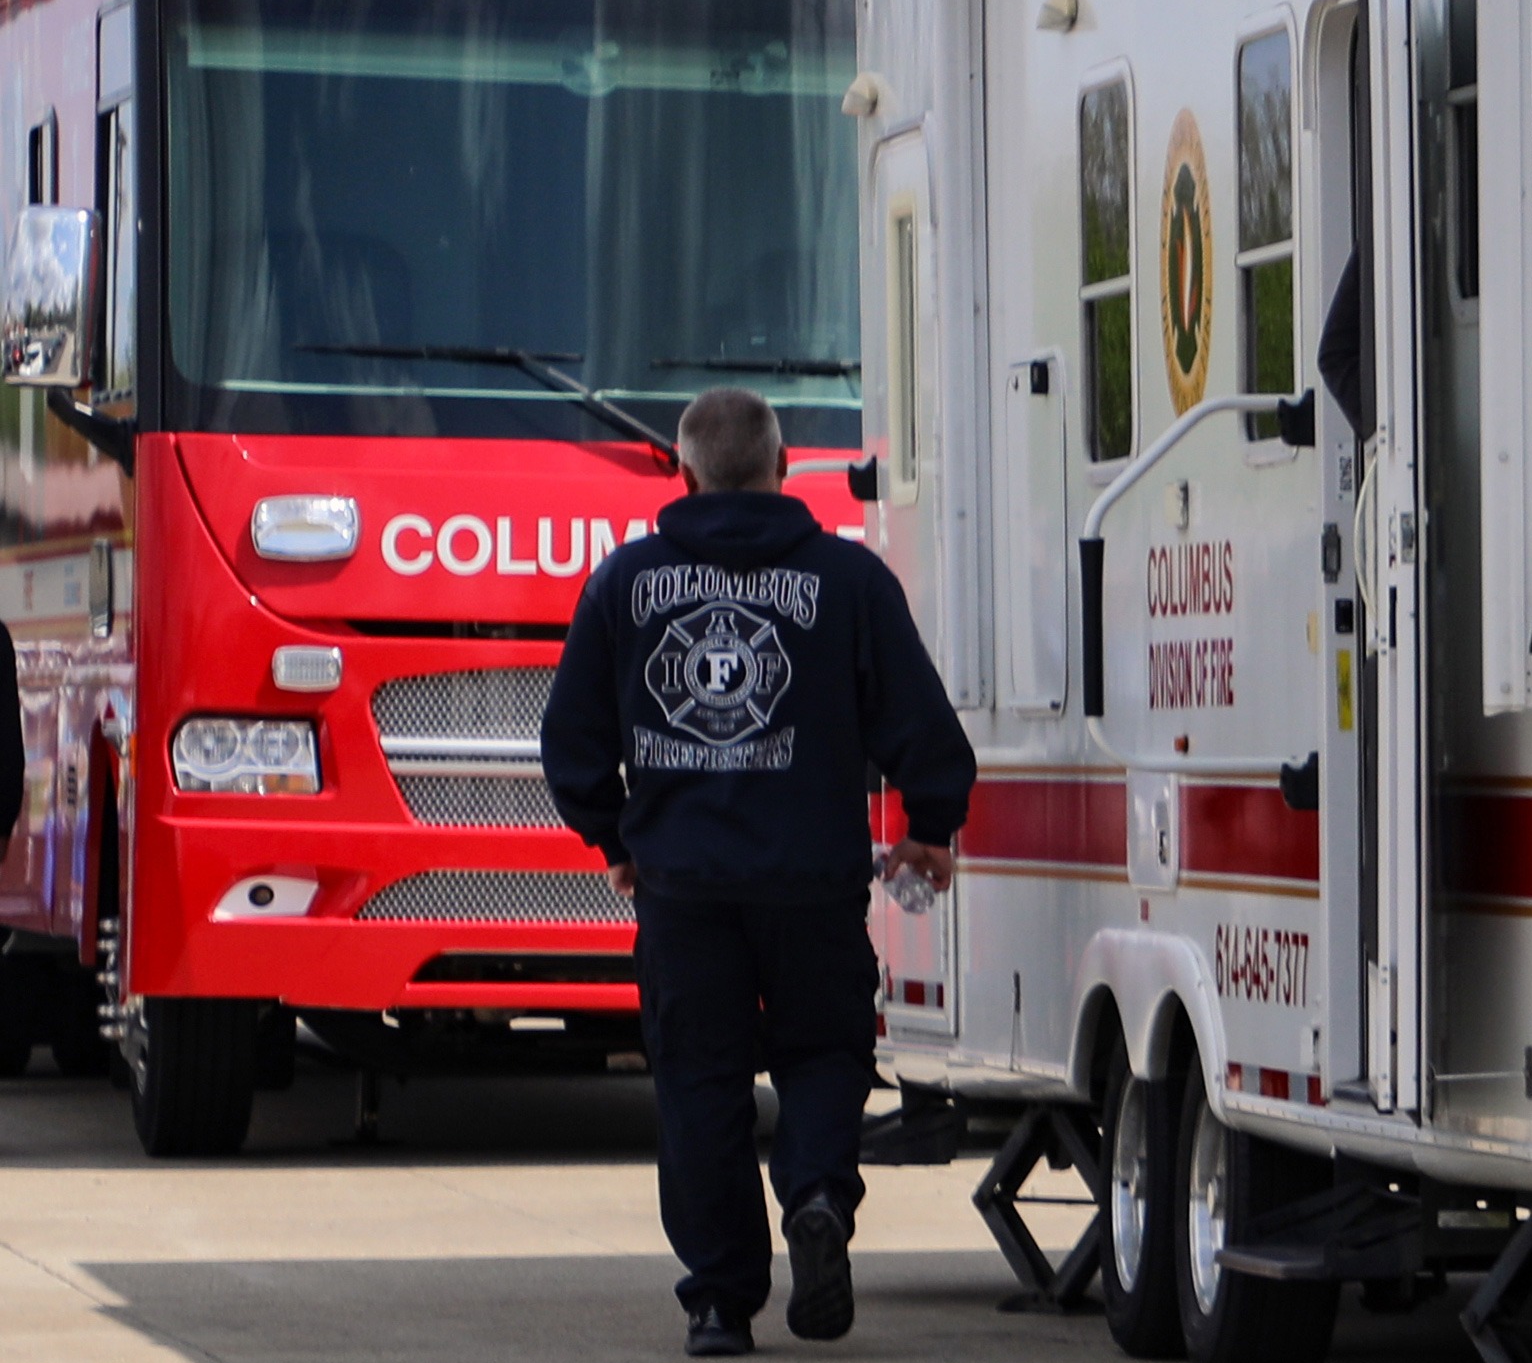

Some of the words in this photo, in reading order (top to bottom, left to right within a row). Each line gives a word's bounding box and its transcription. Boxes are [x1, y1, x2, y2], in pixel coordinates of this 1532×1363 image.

[380, 514, 660, 577] COLUM
[631, 564, 820, 630] COLUMBUS
[1147, 539, 1233, 619] COLUMBUS
[705, 611, 739, 637] A
[661, 652, 681, 694] I
[706, 651, 739, 692] F
[755, 653, 782, 694] F
[1149, 640, 1192, 710] DIVISION
[1194, 638, 1208, 708] OF
[1211, 637, 1234, 707] FIRE
[1215, 923, 1309, 1008] 614-645-7377
